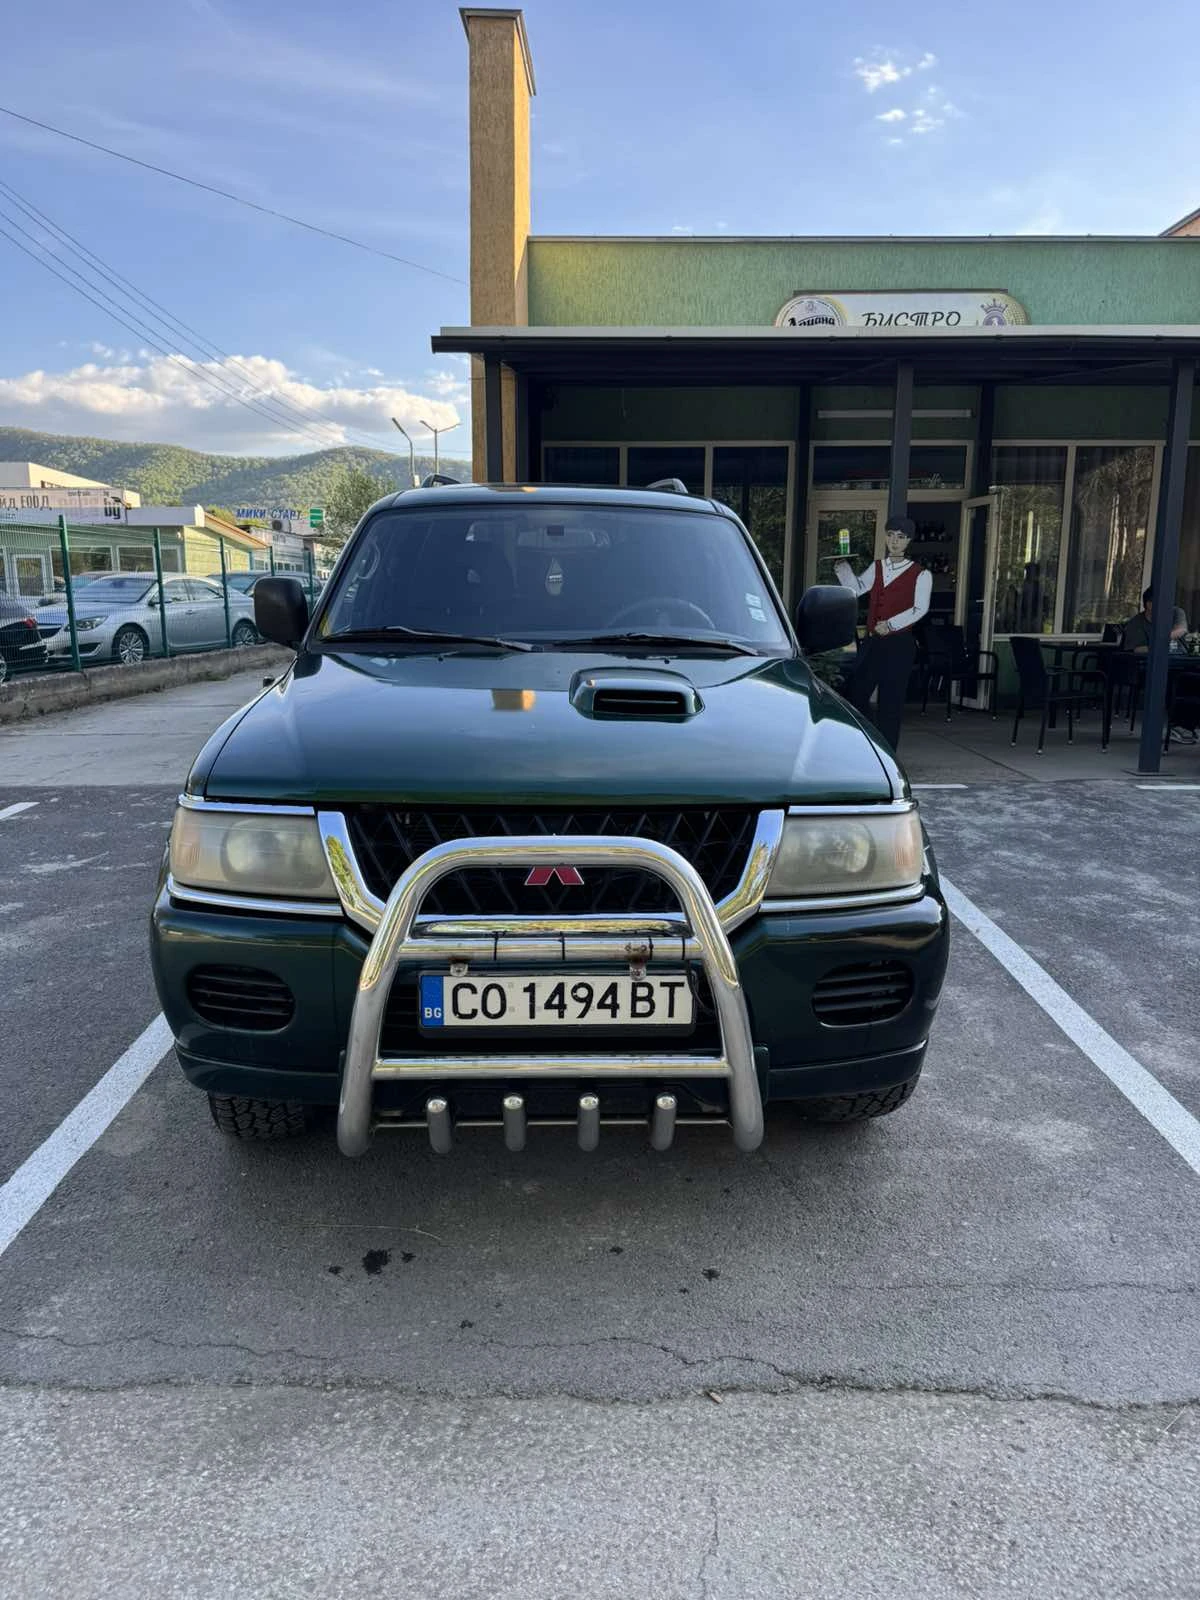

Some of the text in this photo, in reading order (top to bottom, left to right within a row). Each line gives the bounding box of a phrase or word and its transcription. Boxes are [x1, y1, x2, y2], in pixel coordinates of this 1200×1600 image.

[861, 311, 961, 326] БИСТРО
[452, 981, 685, 1020] CO 1494 BT
[424, 1007, 442, 1018] BG
